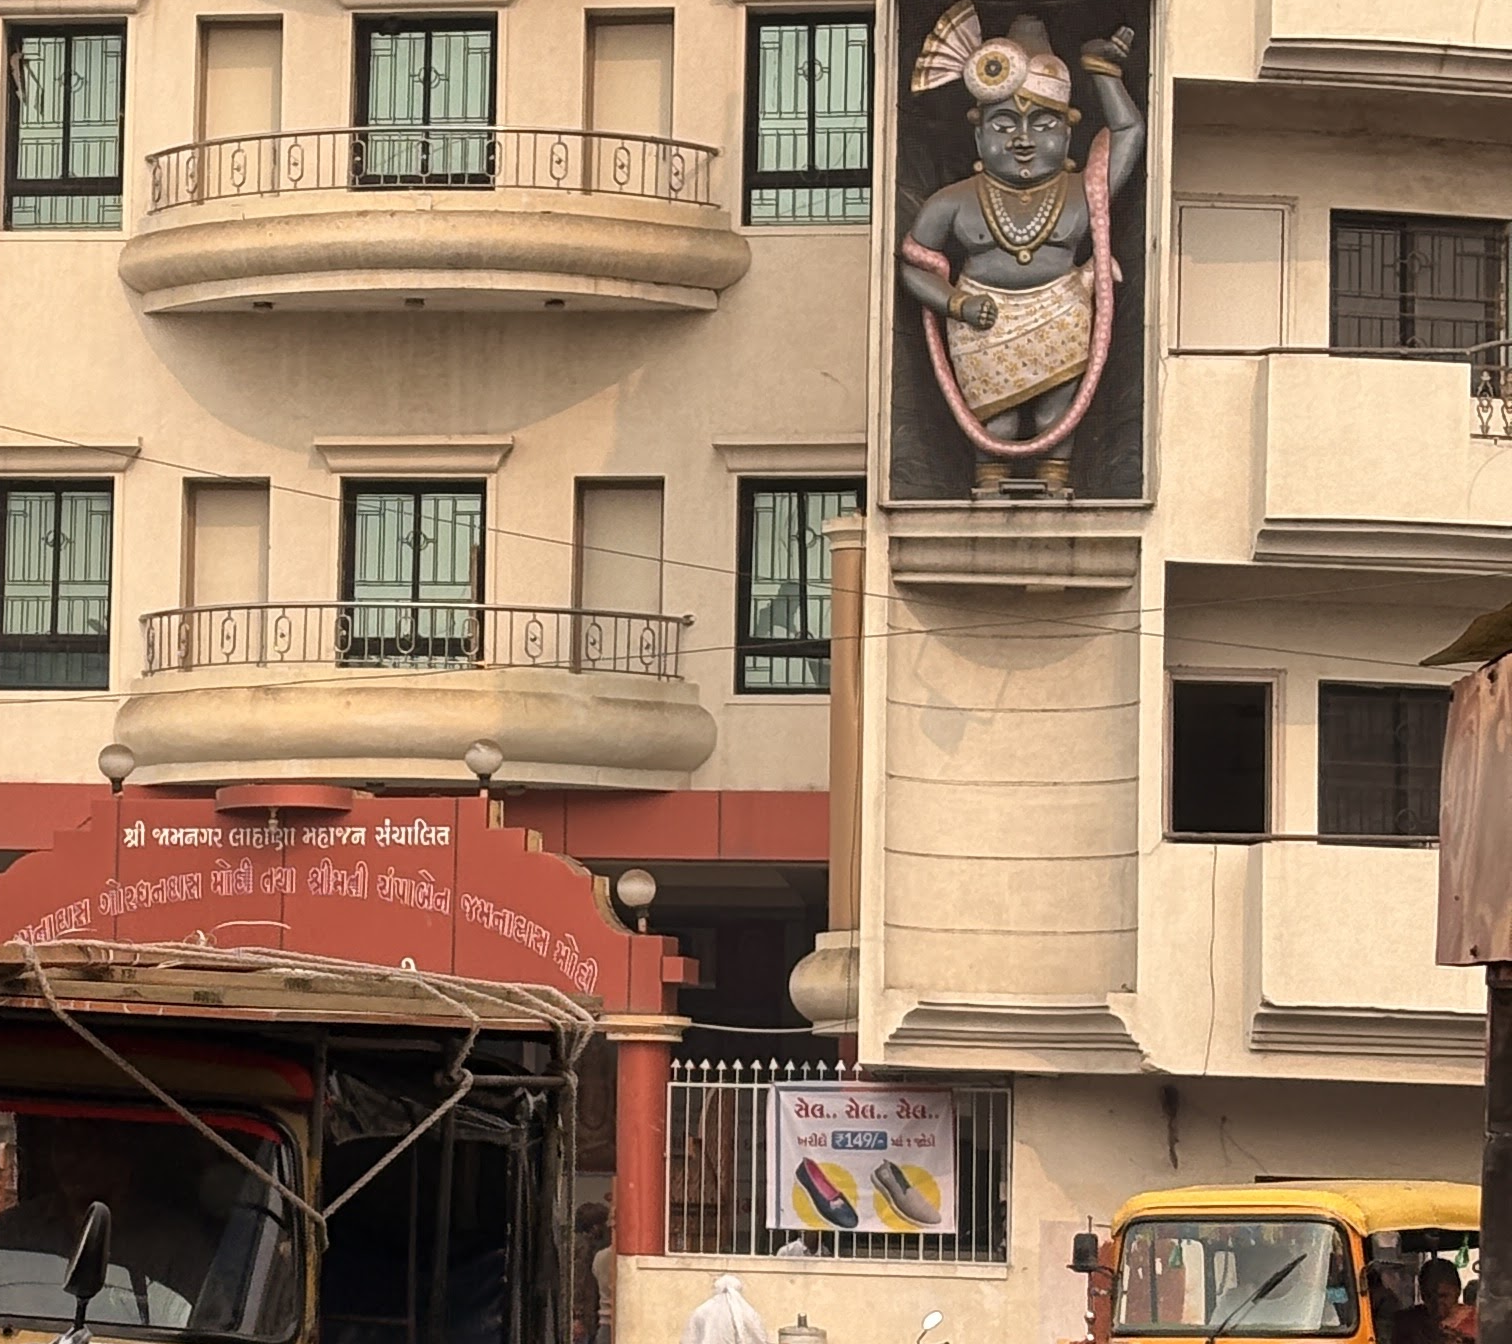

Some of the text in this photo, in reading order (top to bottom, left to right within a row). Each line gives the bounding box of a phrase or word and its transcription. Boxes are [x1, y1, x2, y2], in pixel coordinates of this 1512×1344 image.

[123, 820, 145, 848] શ્રી
[151, 827, 223, 849] જામનગર
[302, 827, 367, 849] મહાજન
[374, 818, 451, 848] સંચાલિત
